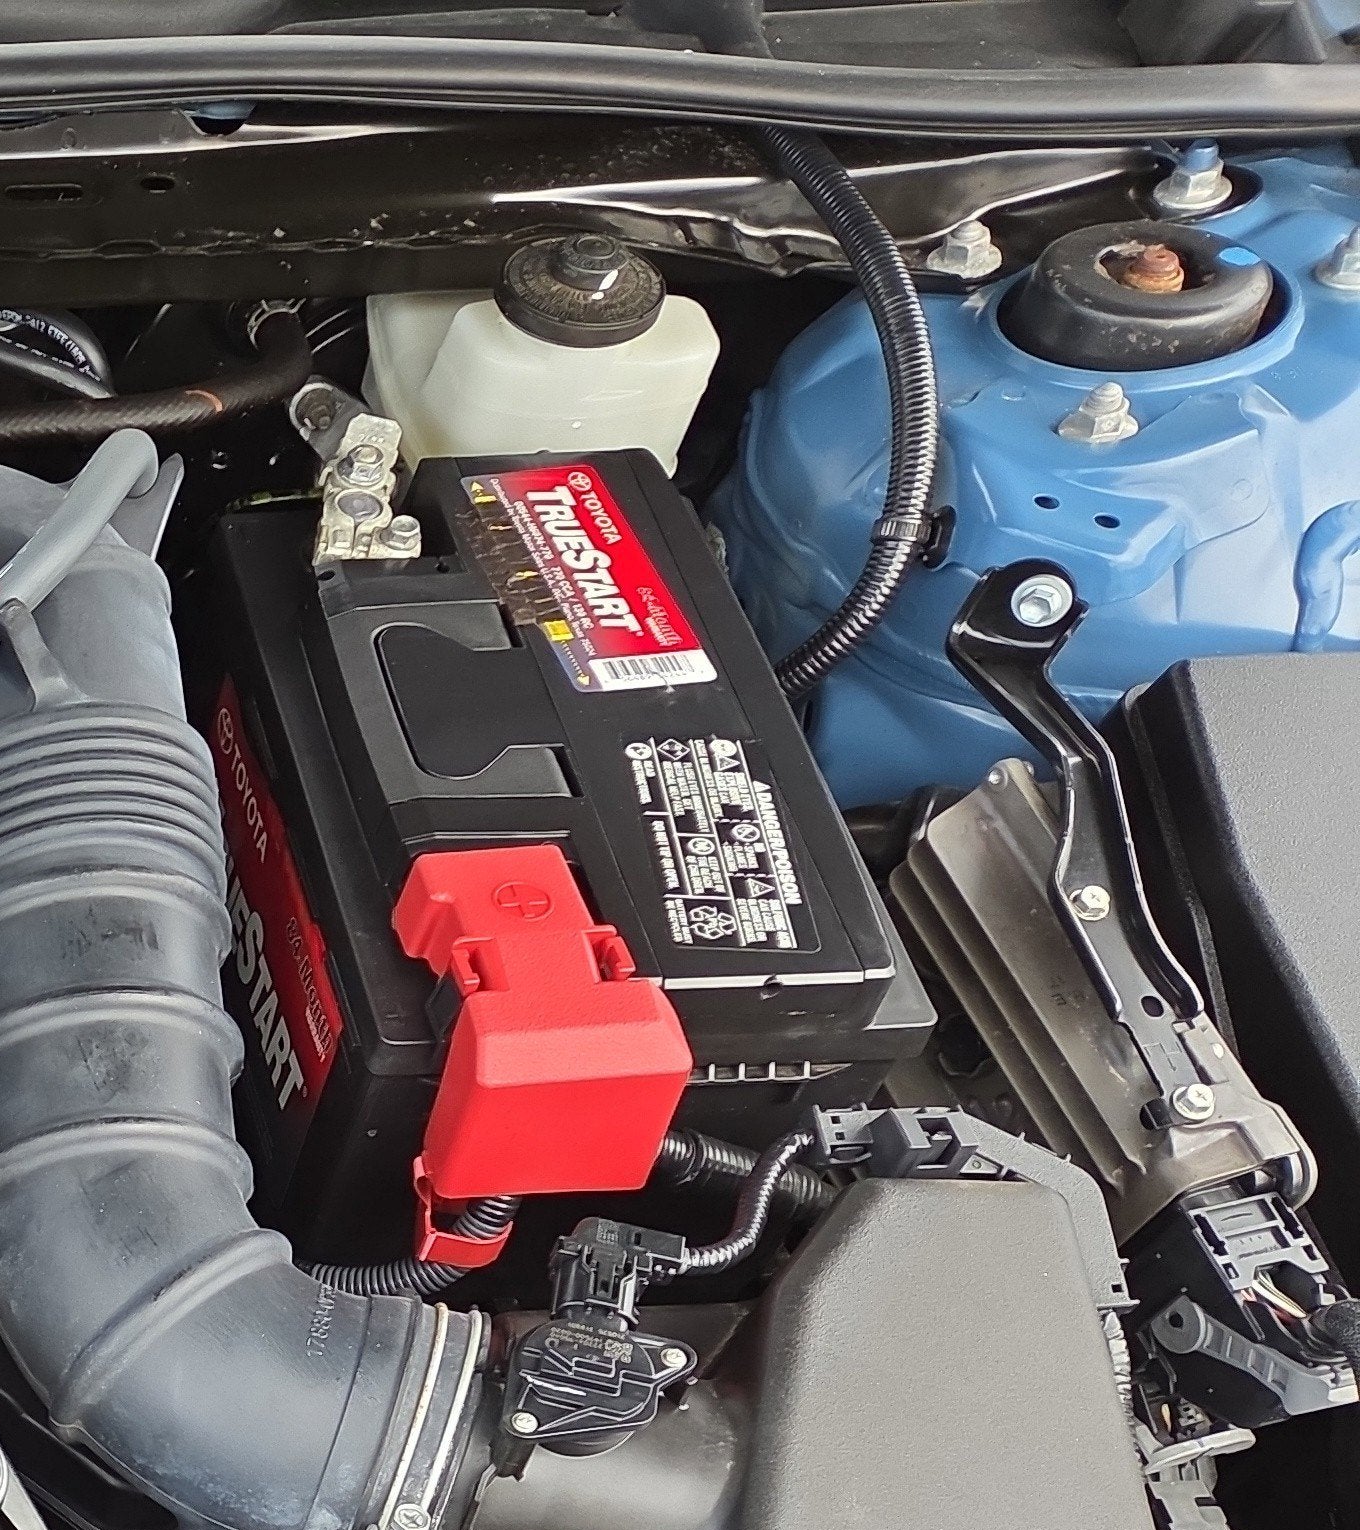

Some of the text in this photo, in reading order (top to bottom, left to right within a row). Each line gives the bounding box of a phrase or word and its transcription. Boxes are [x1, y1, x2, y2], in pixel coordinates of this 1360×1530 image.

[580, 490, 622, 545] TOYOTA
[229, 743, 268, 864] TOYOTA
[758, 792, 803, 905] DANGER/POISON
